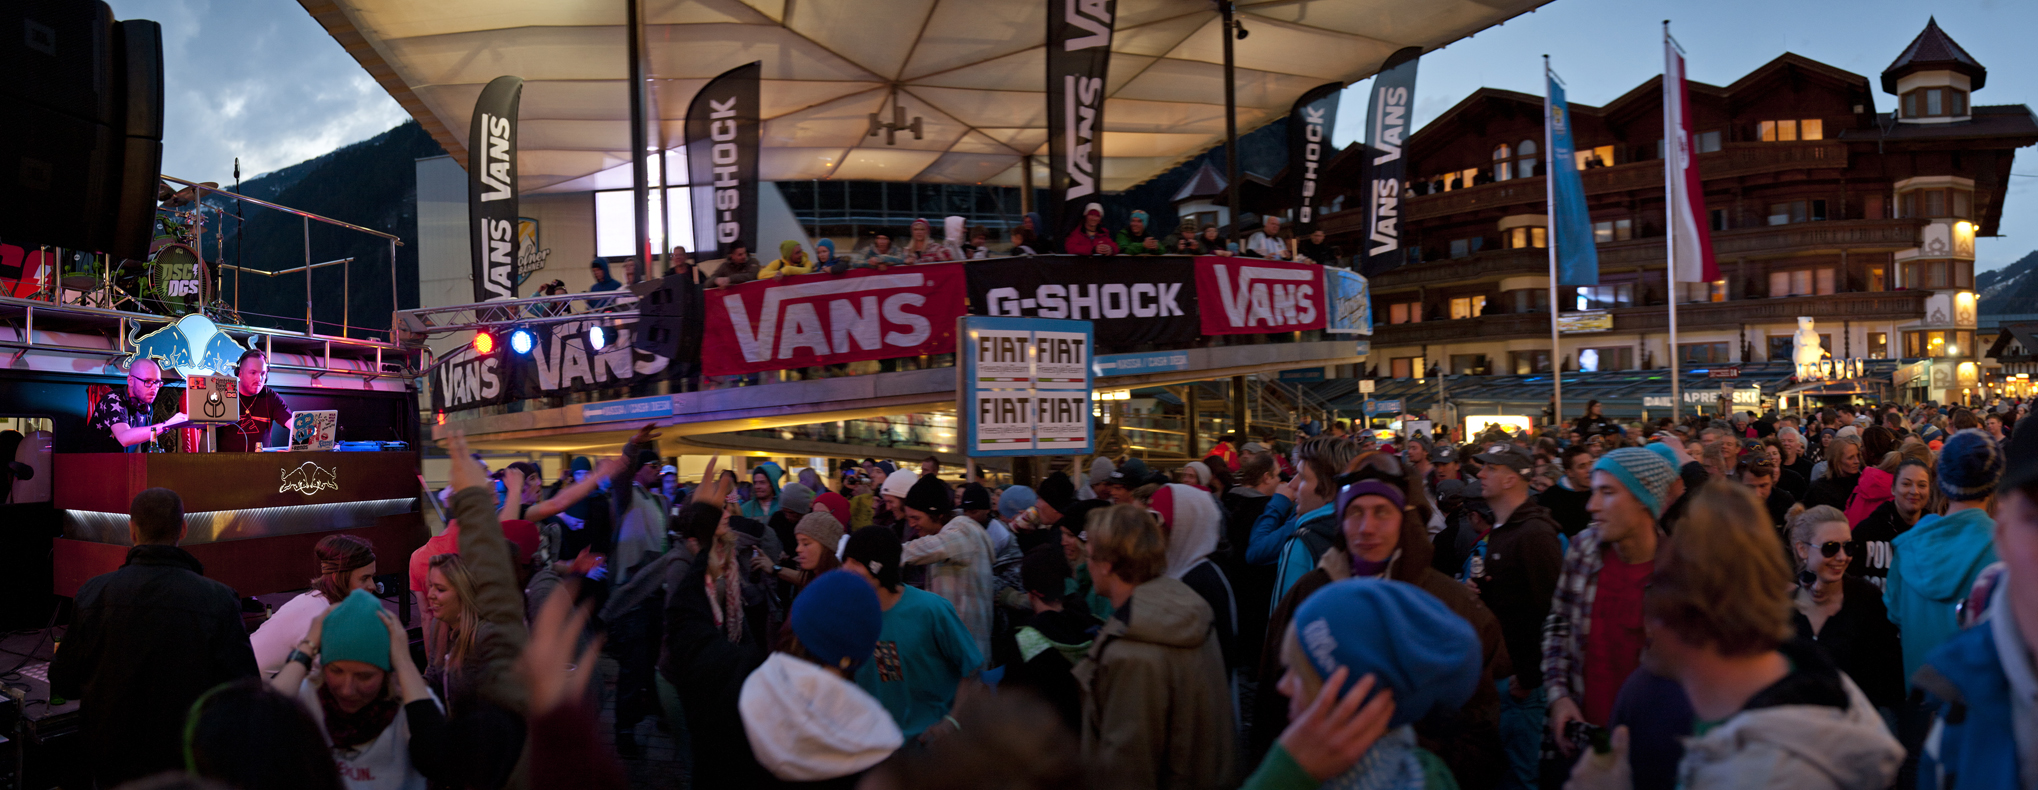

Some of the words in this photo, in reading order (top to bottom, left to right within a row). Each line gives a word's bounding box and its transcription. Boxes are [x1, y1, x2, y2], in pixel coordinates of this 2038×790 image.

[481, 113, 512, 202] VANS
[1065, 74, 1103, 201] VANS
[1374, 86, 1408, 166] VANS
[709, 96, 740, 243] G-SHOCK
[1300, 106, 1325, 223] G-SHOCK
[1369, 178, 1399, 257] VANS
[168, 280, 199, 296] DGS
[481, 217, 512, 303] VANS
[723, 272, 932, 362] VANS
[986, 282, 1186, 320] G-SHOCK
[1213, 264, 1317, 327] VANS
[439, 343, 501, 408] VANS
[979, 336, 1029, 362] FIAT
[1037, 338, 1083, 363] FIAT
[980, 397, 1030, 423] FIAT
[1038, 398, 1084, 423] FIAT
[1643, 396, 1679, 407] DAIL
[1684, 392, 1721, 403] APRE
[1732, 391, 1757, 403] SKI
